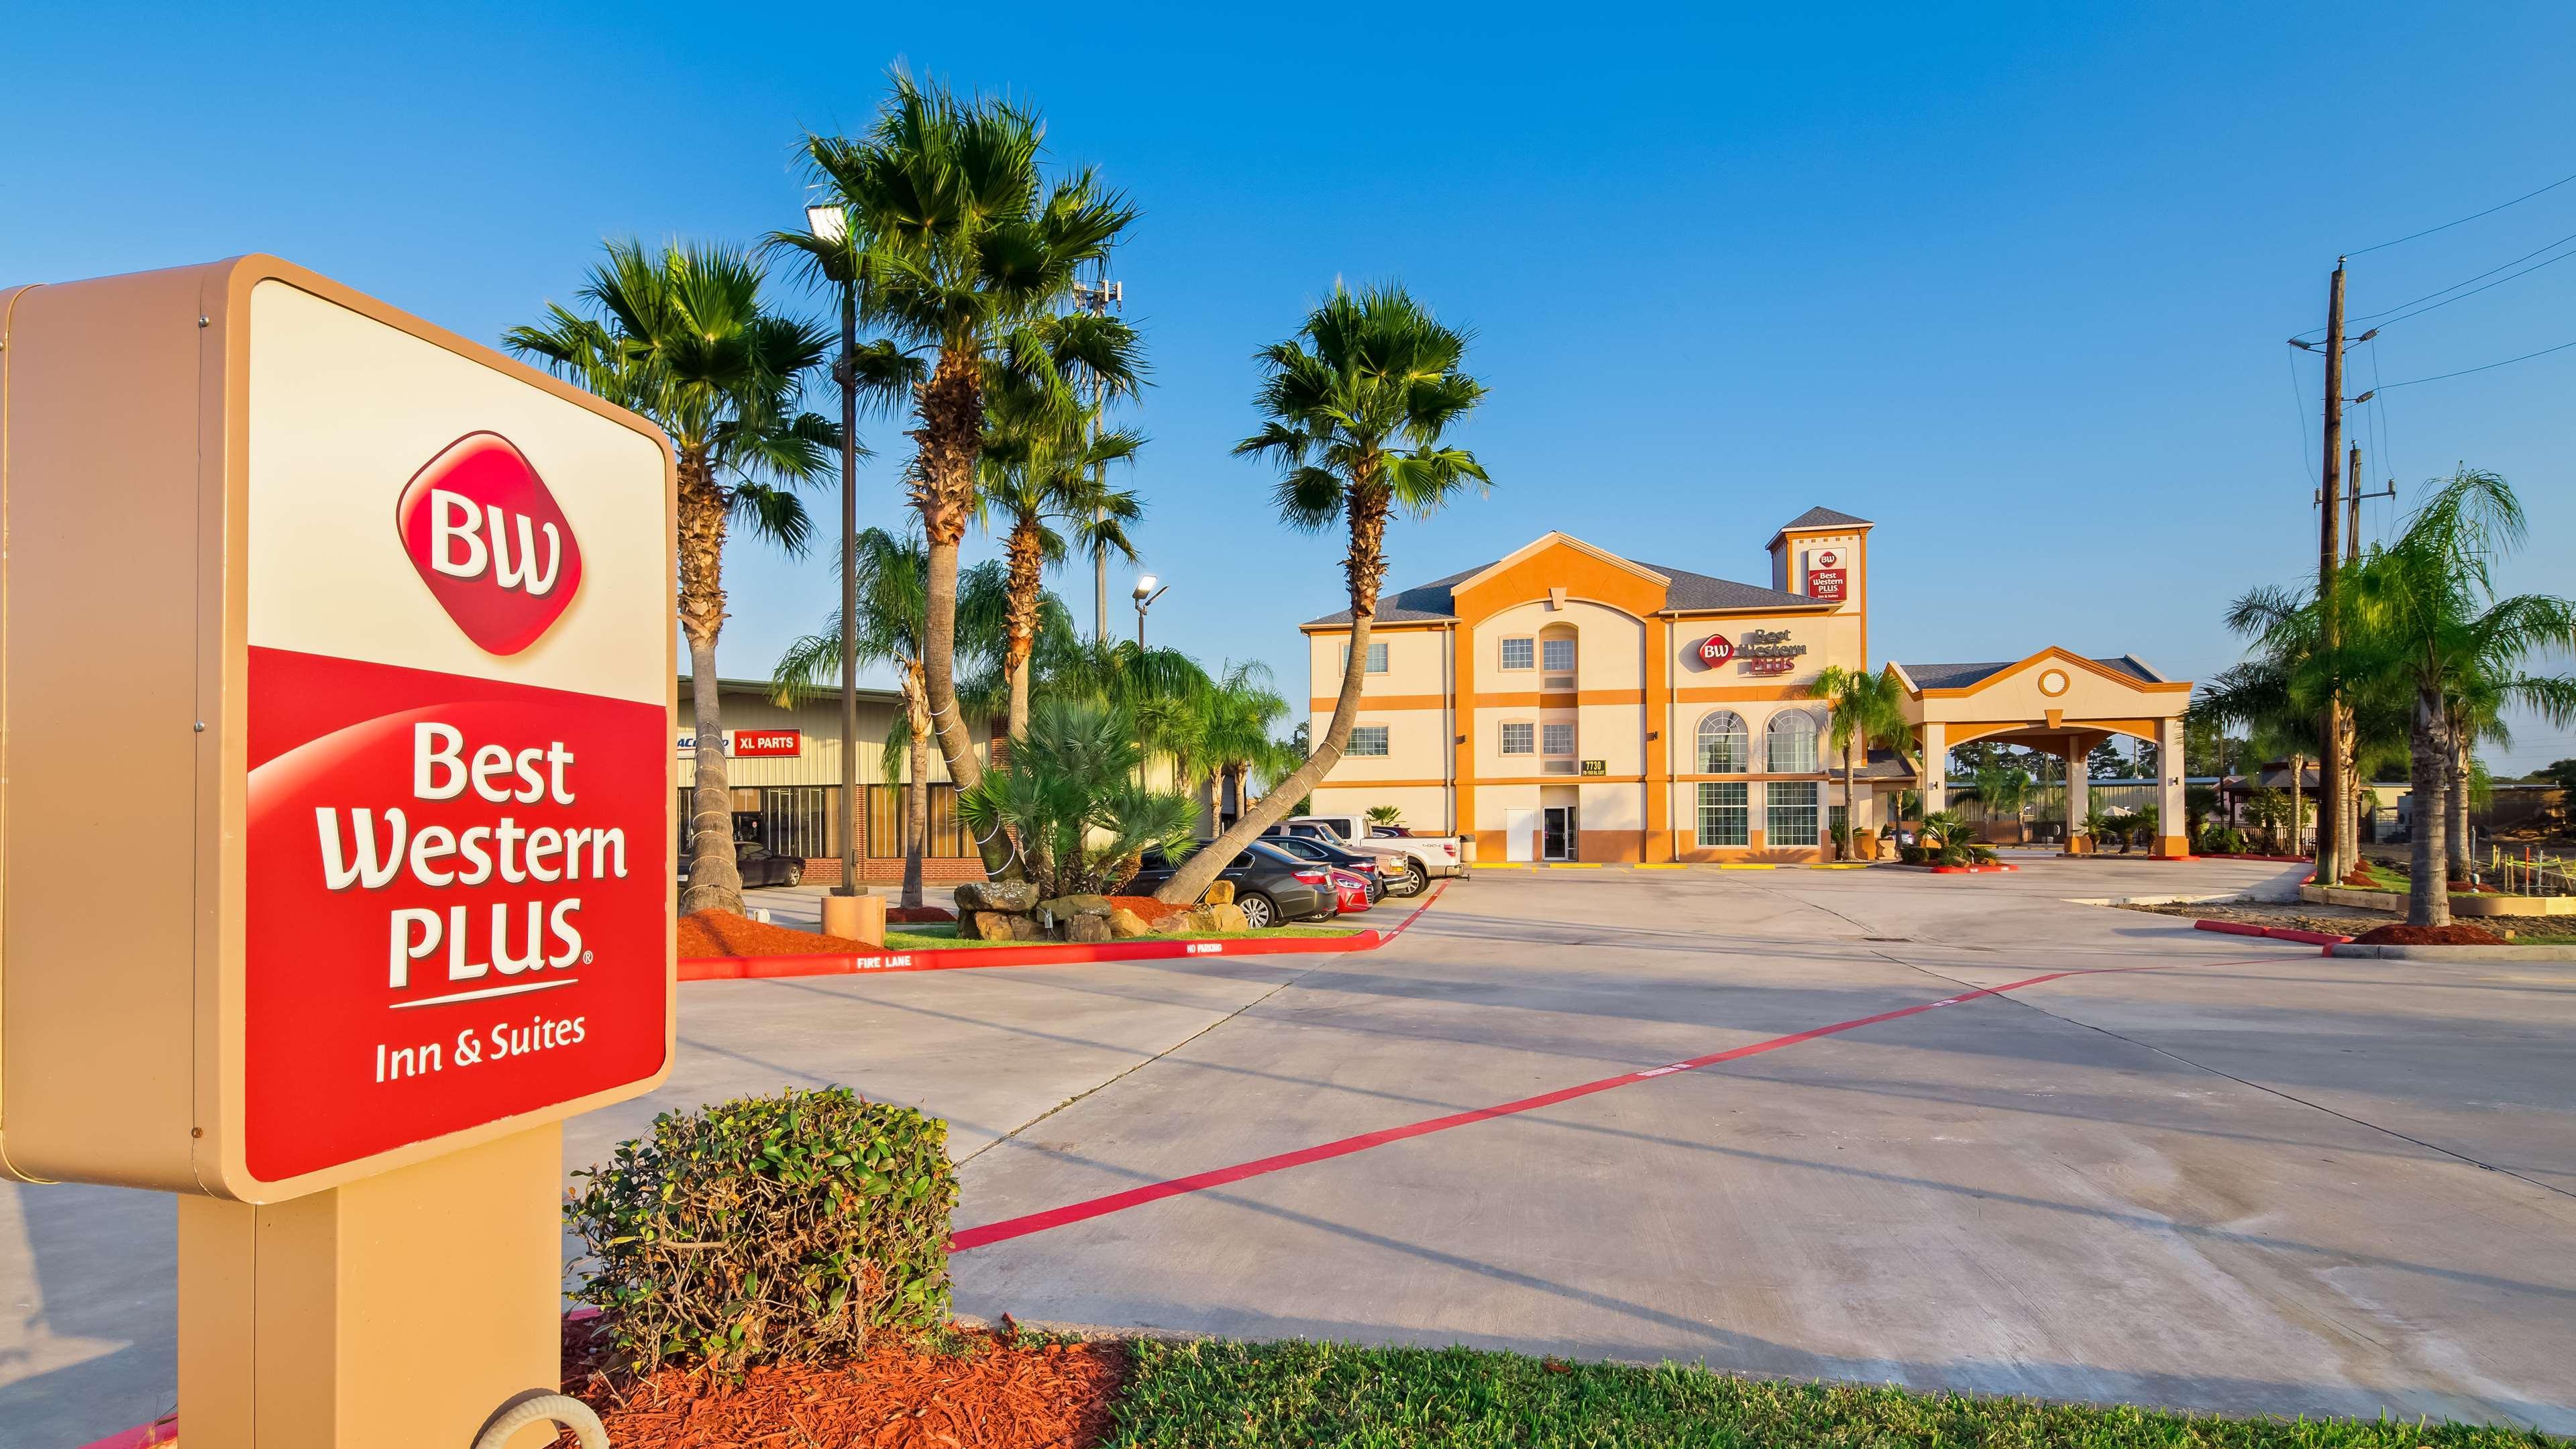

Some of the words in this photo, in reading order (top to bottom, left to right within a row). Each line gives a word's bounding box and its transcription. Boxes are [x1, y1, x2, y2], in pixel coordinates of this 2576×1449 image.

[431, 488, 561, 596] BW
[1821, 555, 1835, 564] BW
[1755, 629, 1792, 643] Best
[1705, 644, 1729, 658] BW
[1739, 643, 1808, 657] Western
[1751, 656, 1795, 672] PLUS
[740, 738, 755, 749] XL
[758, 737, 794, 749] PARTS
[415, 722, 576, 804] Best
[1586, 761, 1601, 770] 7730
[315, 807, 628, 890] Western
[1187, 944, 1195, 953] NO
[1197, 944, 1222, 953] PARKING
[857, 957, 881, 969] FIRE
[885, 955, 912, 967] LANE
[376, 1044, 443, 1083] Inn
[455, 1030, 482, 1066] &
[490, 1016, 586, 1060] Suites
